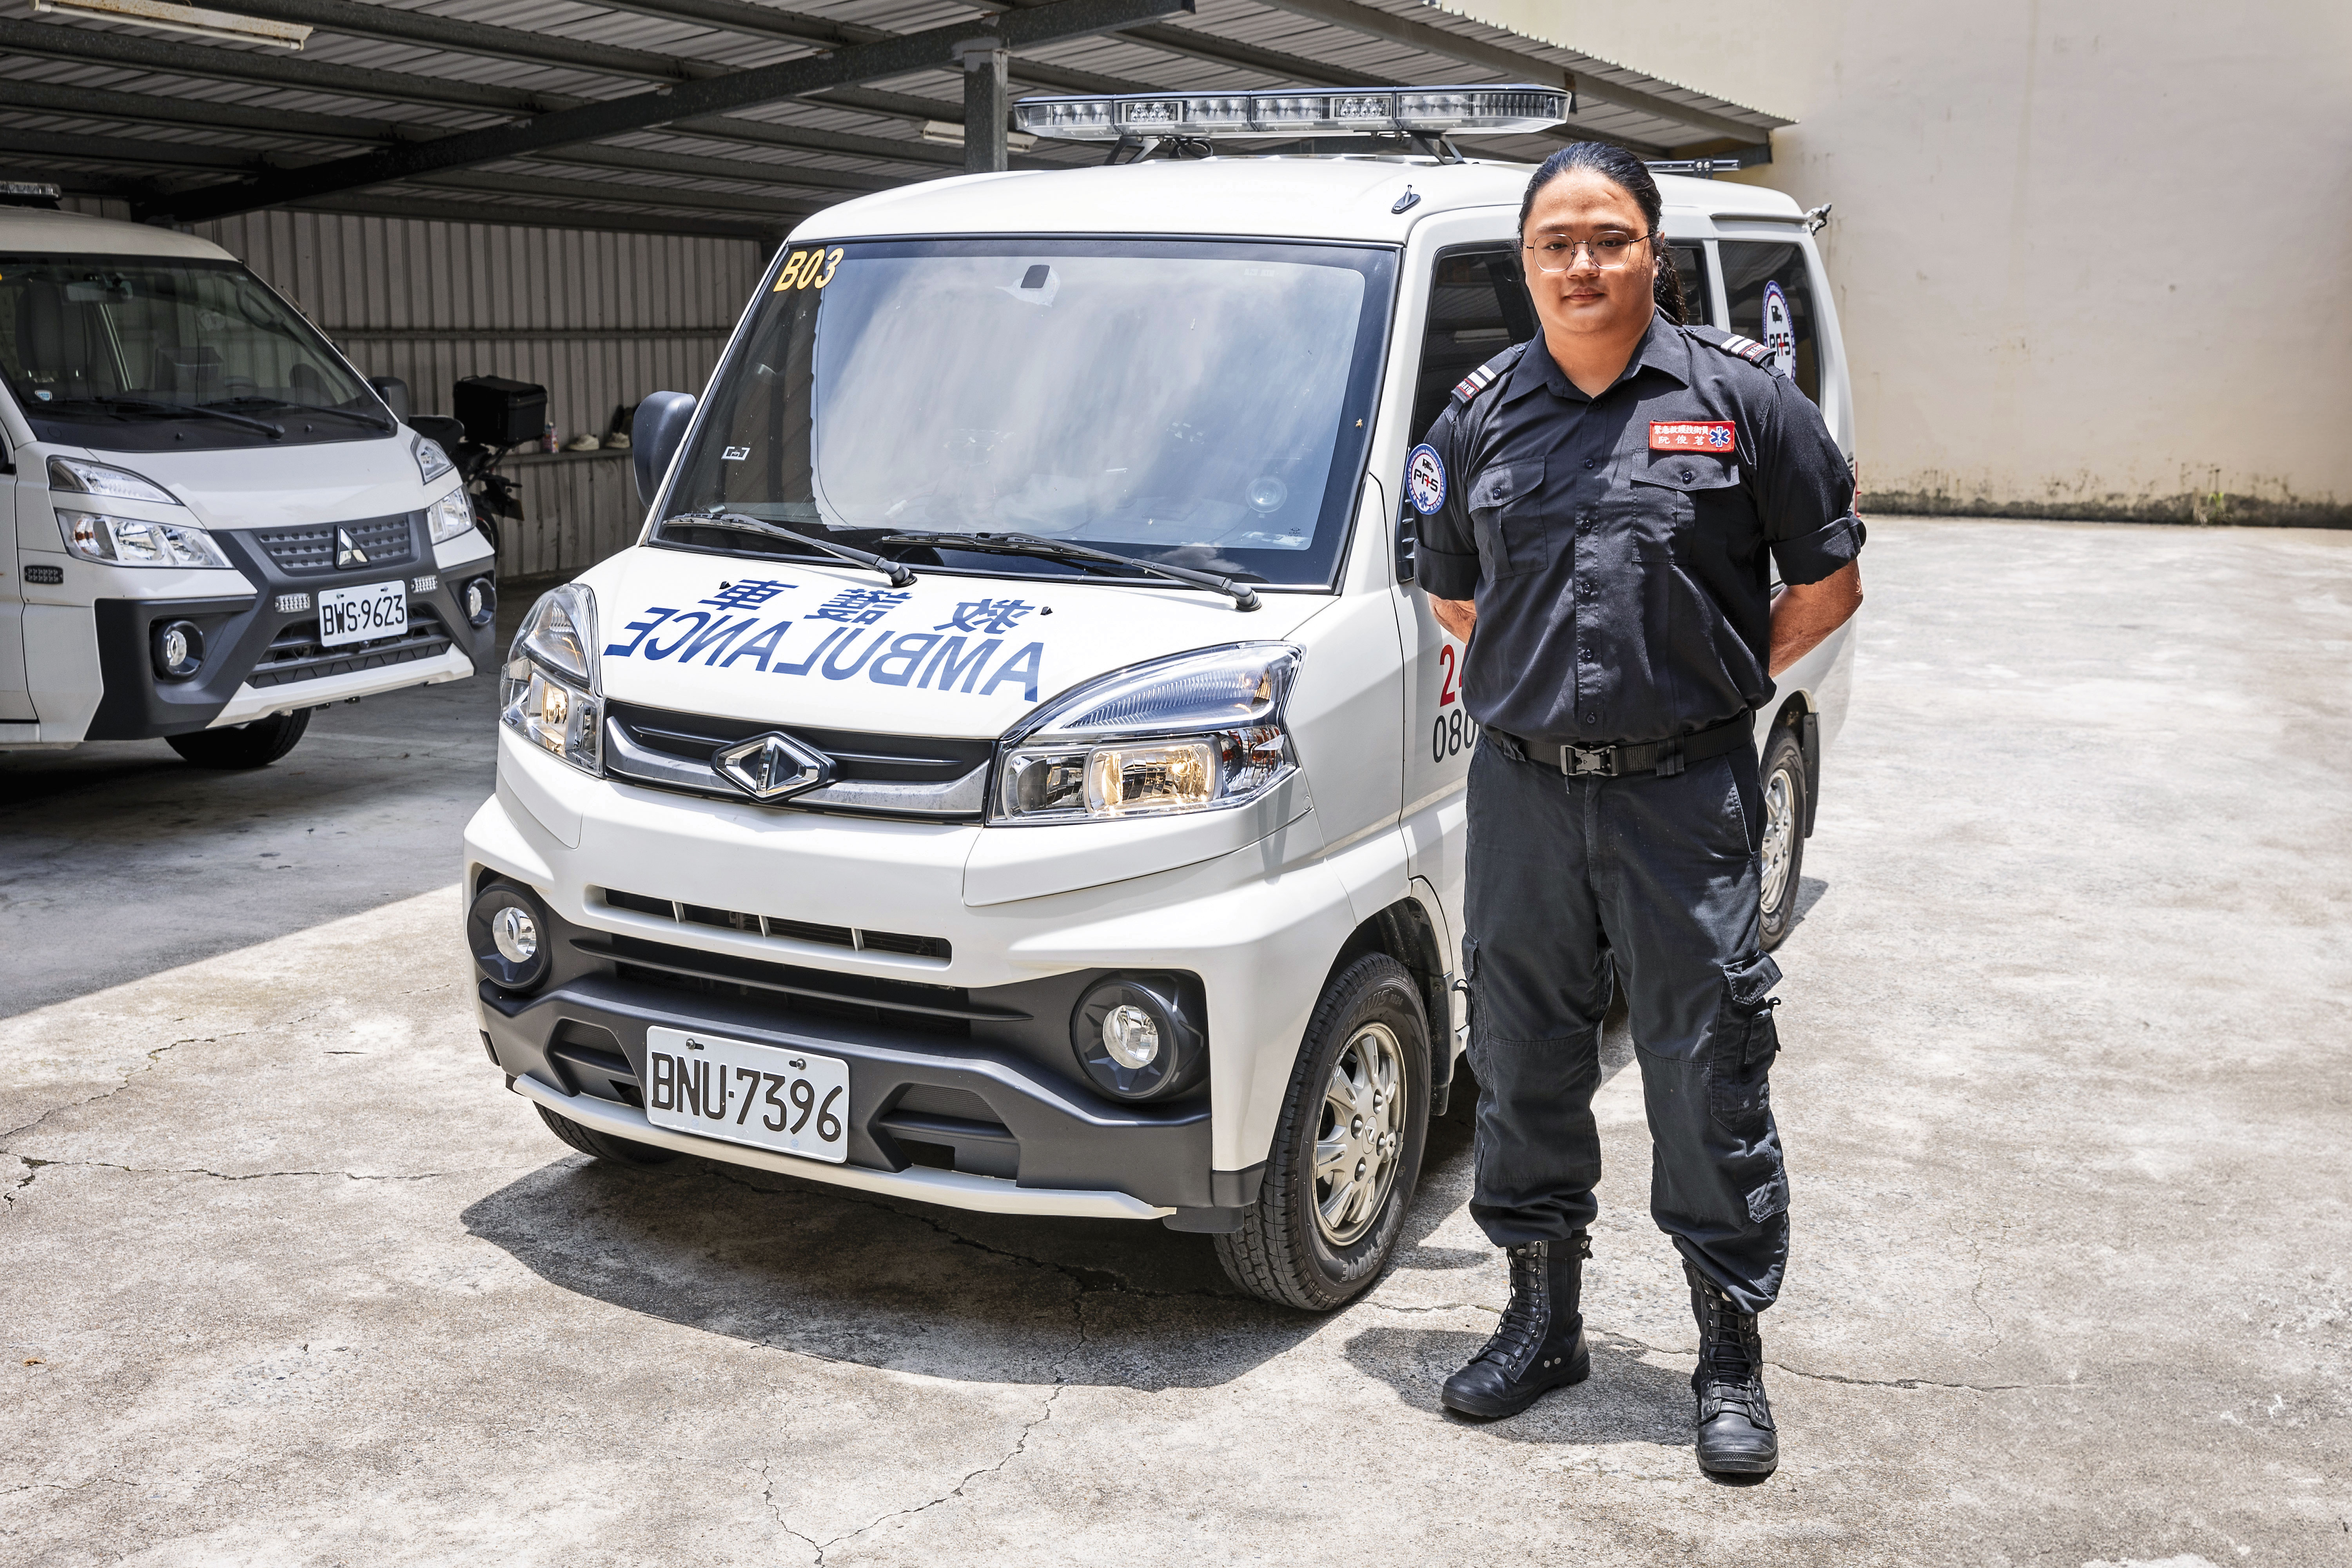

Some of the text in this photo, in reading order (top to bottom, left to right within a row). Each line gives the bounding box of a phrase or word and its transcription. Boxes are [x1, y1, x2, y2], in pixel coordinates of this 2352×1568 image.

[773, 248, 844, 292] B03
[1654, 425, 1709, 435] 緊急救護技術員
[1658, 435, 1705, 446] 阮俊茗
[1439, 644, 1467, 707] 2
